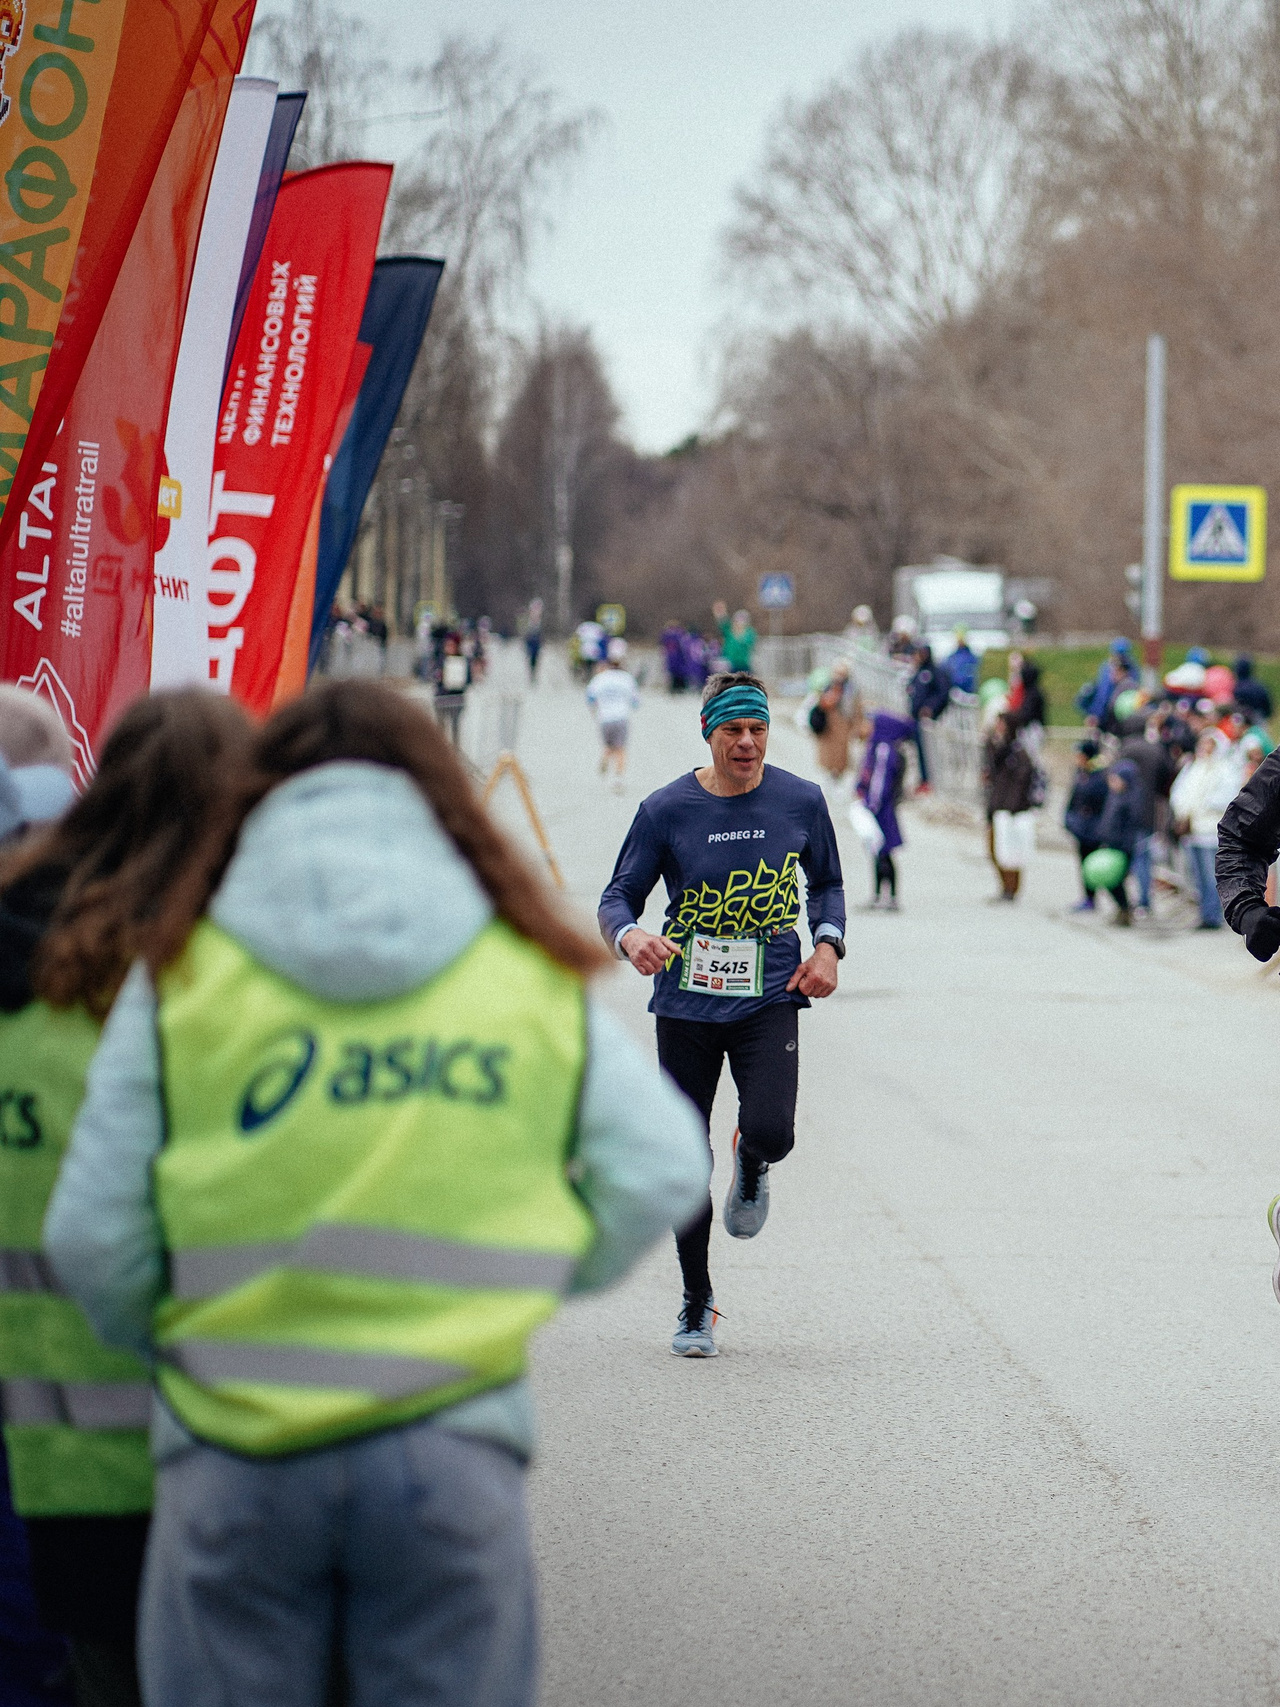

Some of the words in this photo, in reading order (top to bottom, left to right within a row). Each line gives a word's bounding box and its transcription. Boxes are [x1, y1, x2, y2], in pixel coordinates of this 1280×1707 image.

[242, 260, 291, 446] ФИНАНСОВЫХ
[270, 274, 318, 448] ТЕХНОЛОГИЙ
[60, 440, 100, 639] #altaiultratrail
[708, 831, 750, 844] PROBEG
[752, 829, 766, 839] 22
[708, 960, 750, 975] 5415
[327, 1035, 510, 1107] asics
